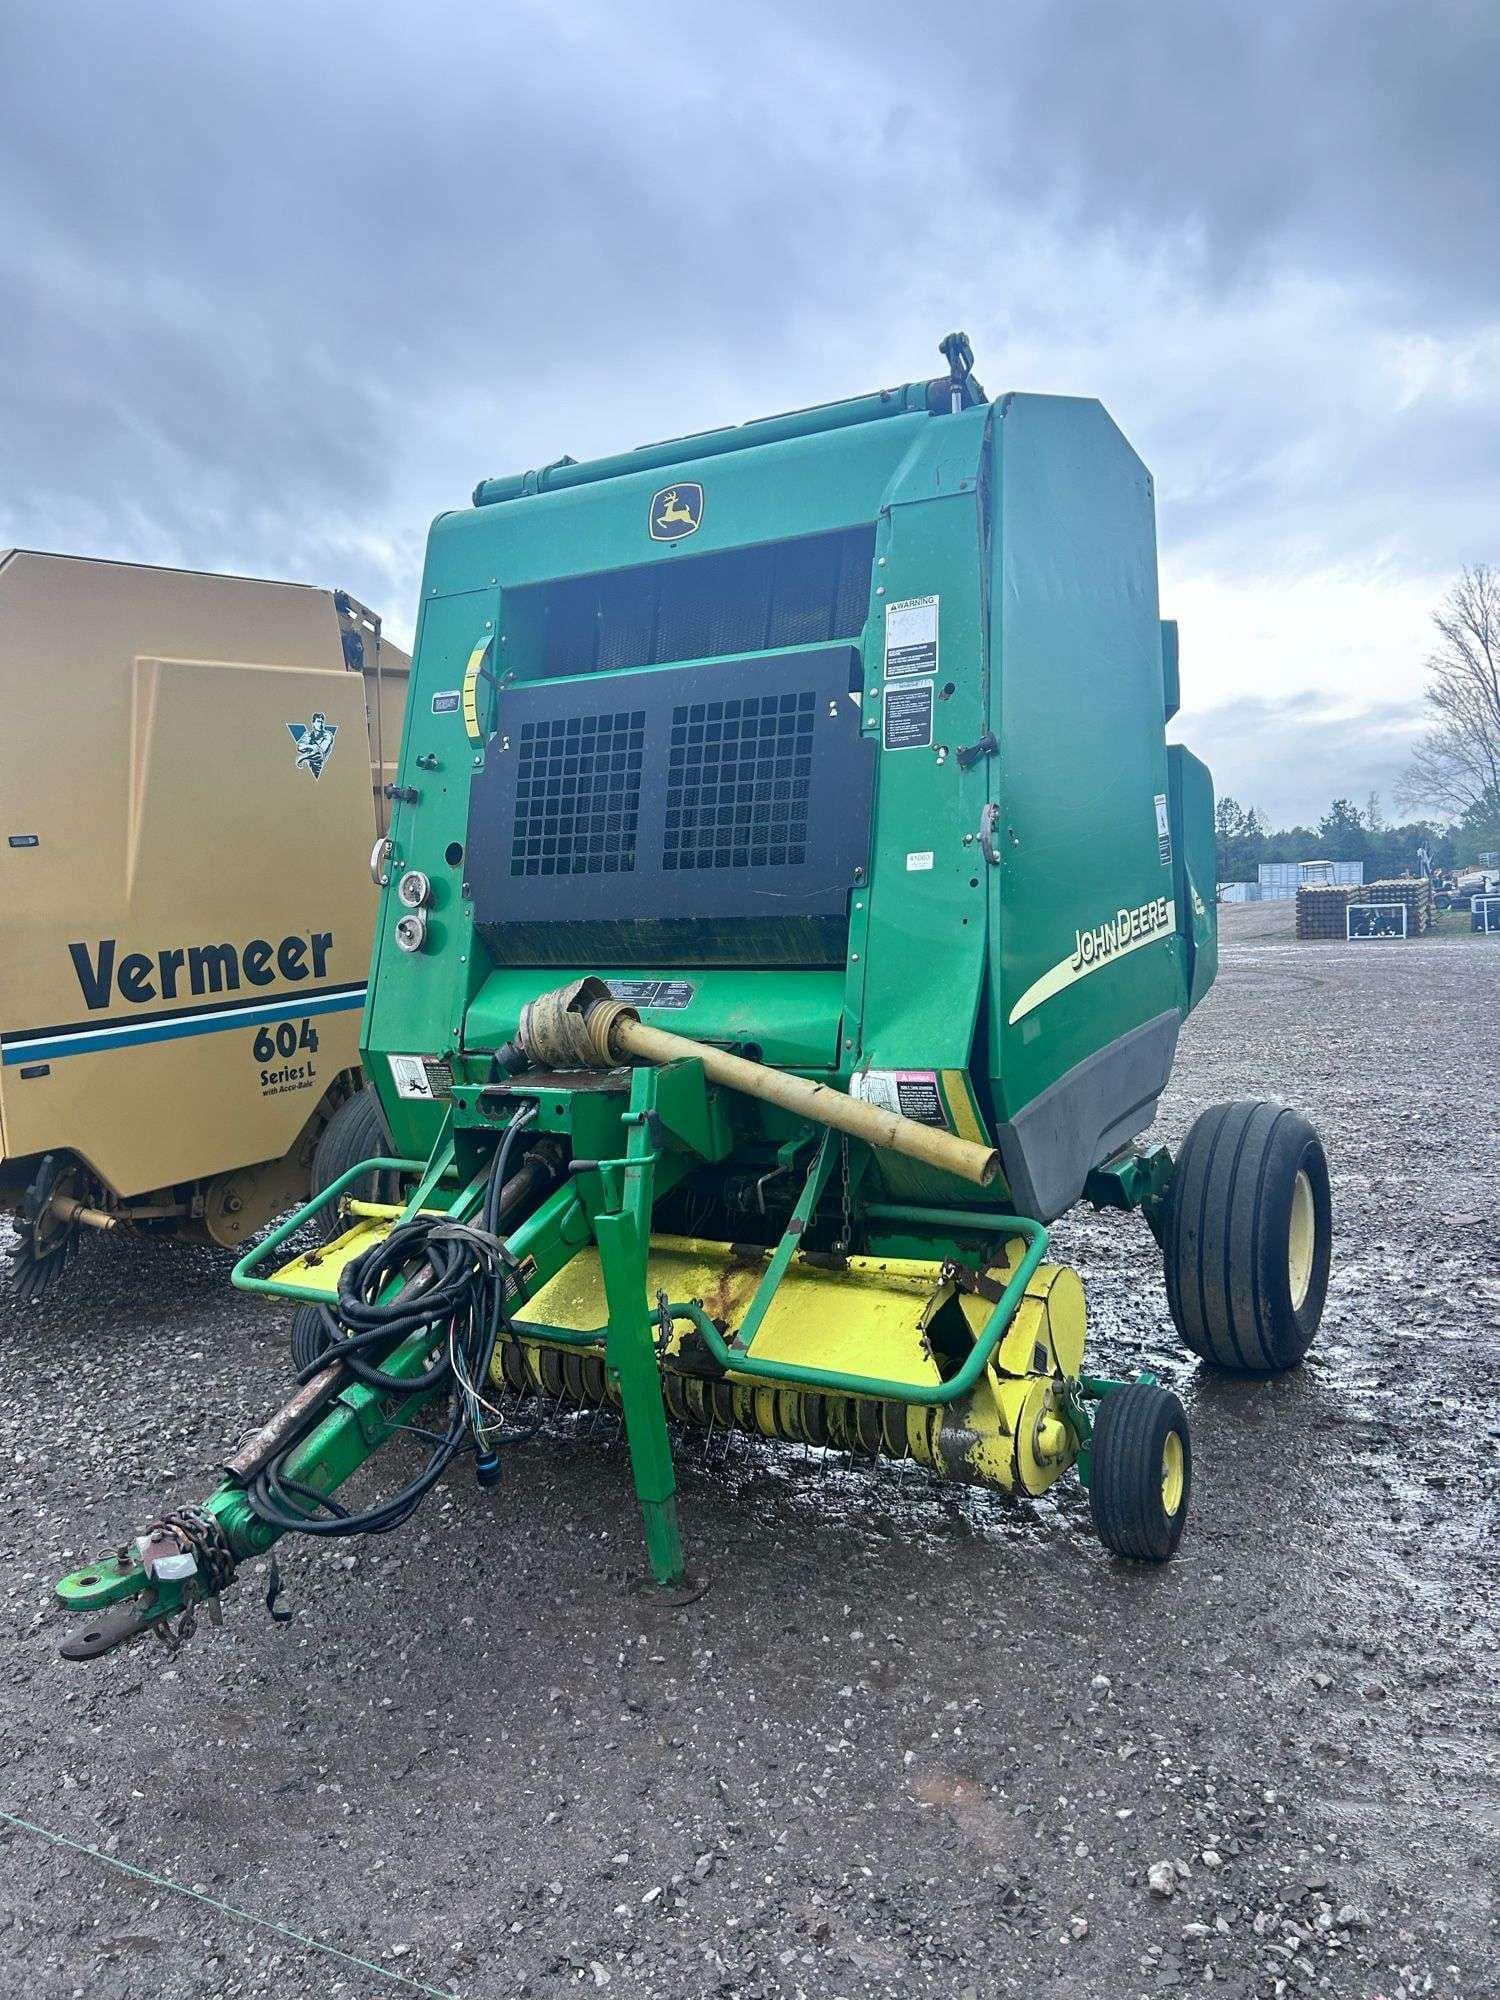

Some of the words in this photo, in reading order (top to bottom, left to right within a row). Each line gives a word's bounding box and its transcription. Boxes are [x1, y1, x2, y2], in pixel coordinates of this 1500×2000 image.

[897, 596, 935, 609] WARNING
[68, 932, 333, 1011] Vermeer
[253, 1018, 319, 1063] 604
[260, 1065, 305, 1087] Series
[306, 1060, 316, 1077] L
[262, 1086, 278, 1097] with
